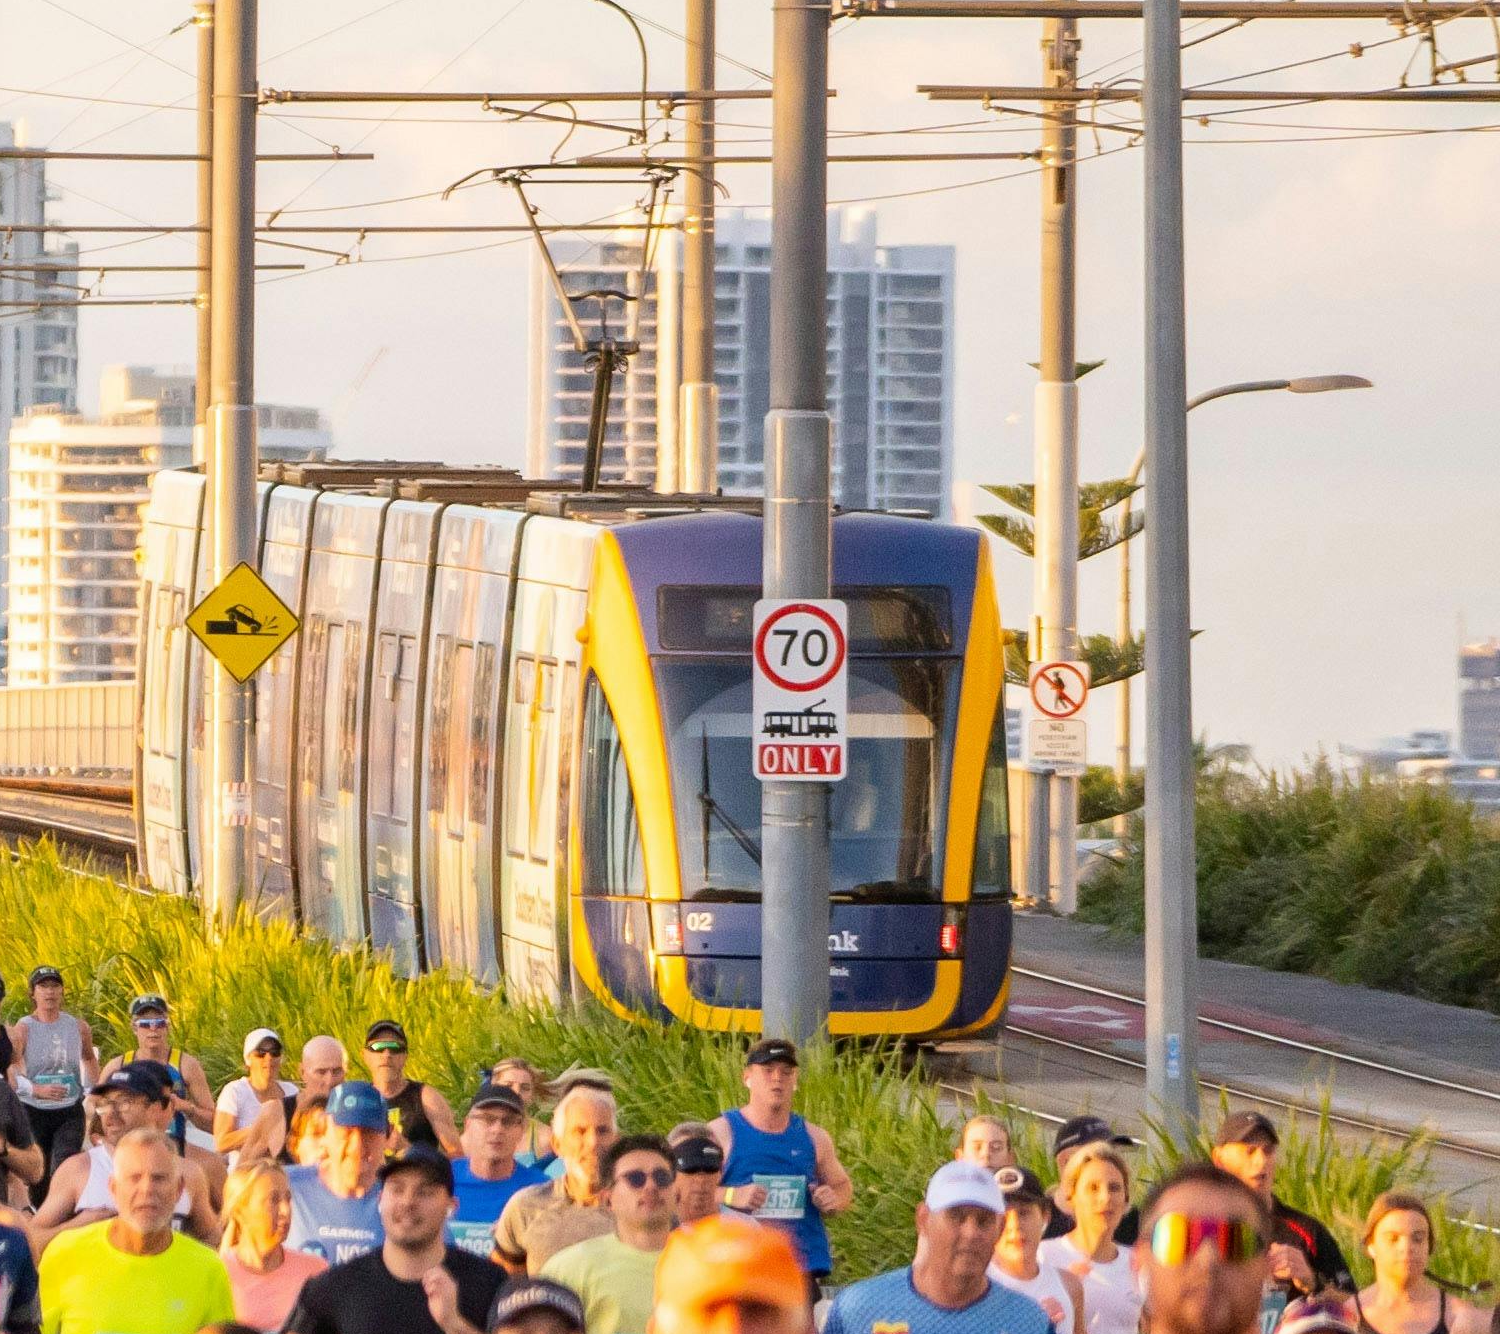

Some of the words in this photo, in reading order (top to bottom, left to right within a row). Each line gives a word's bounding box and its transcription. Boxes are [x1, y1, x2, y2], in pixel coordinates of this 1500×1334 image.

[771, 630, 829, 667] 70
[762, 747, 839, 773] ONLY
[686, 911, 712, 931] 02
